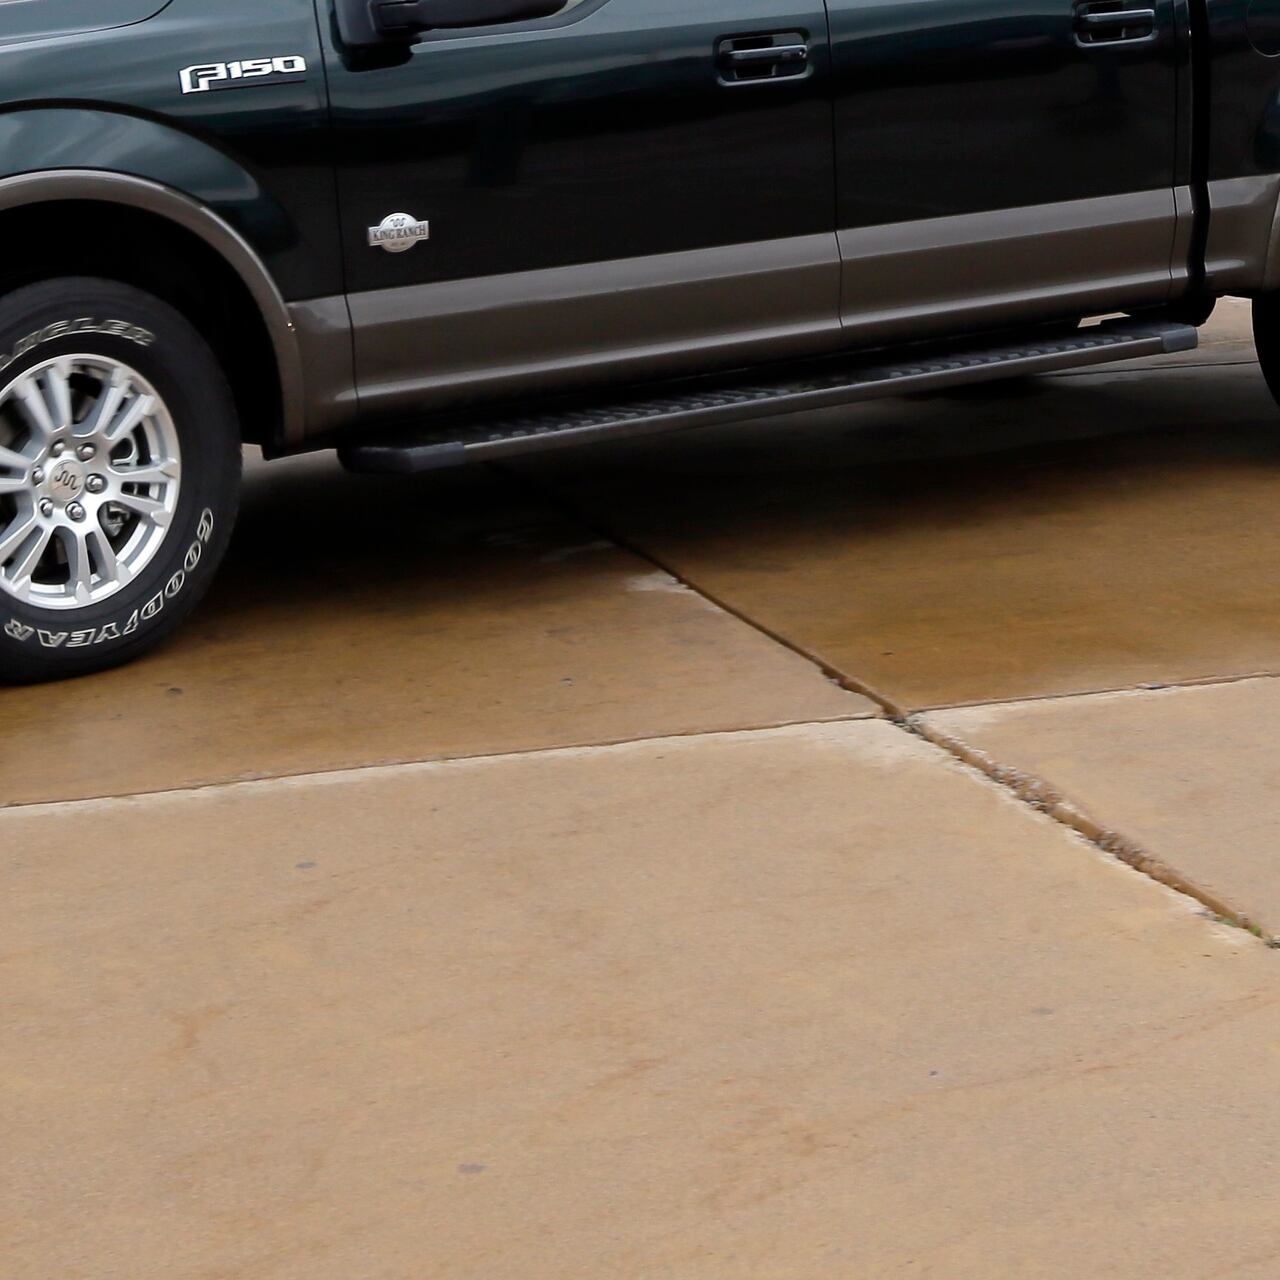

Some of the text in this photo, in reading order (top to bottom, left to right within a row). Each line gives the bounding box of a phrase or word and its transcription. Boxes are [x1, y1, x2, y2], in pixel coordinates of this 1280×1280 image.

[372, 223, 427, 241] KING RANCH
[4, 507, 214, 648] GOODYEAR
